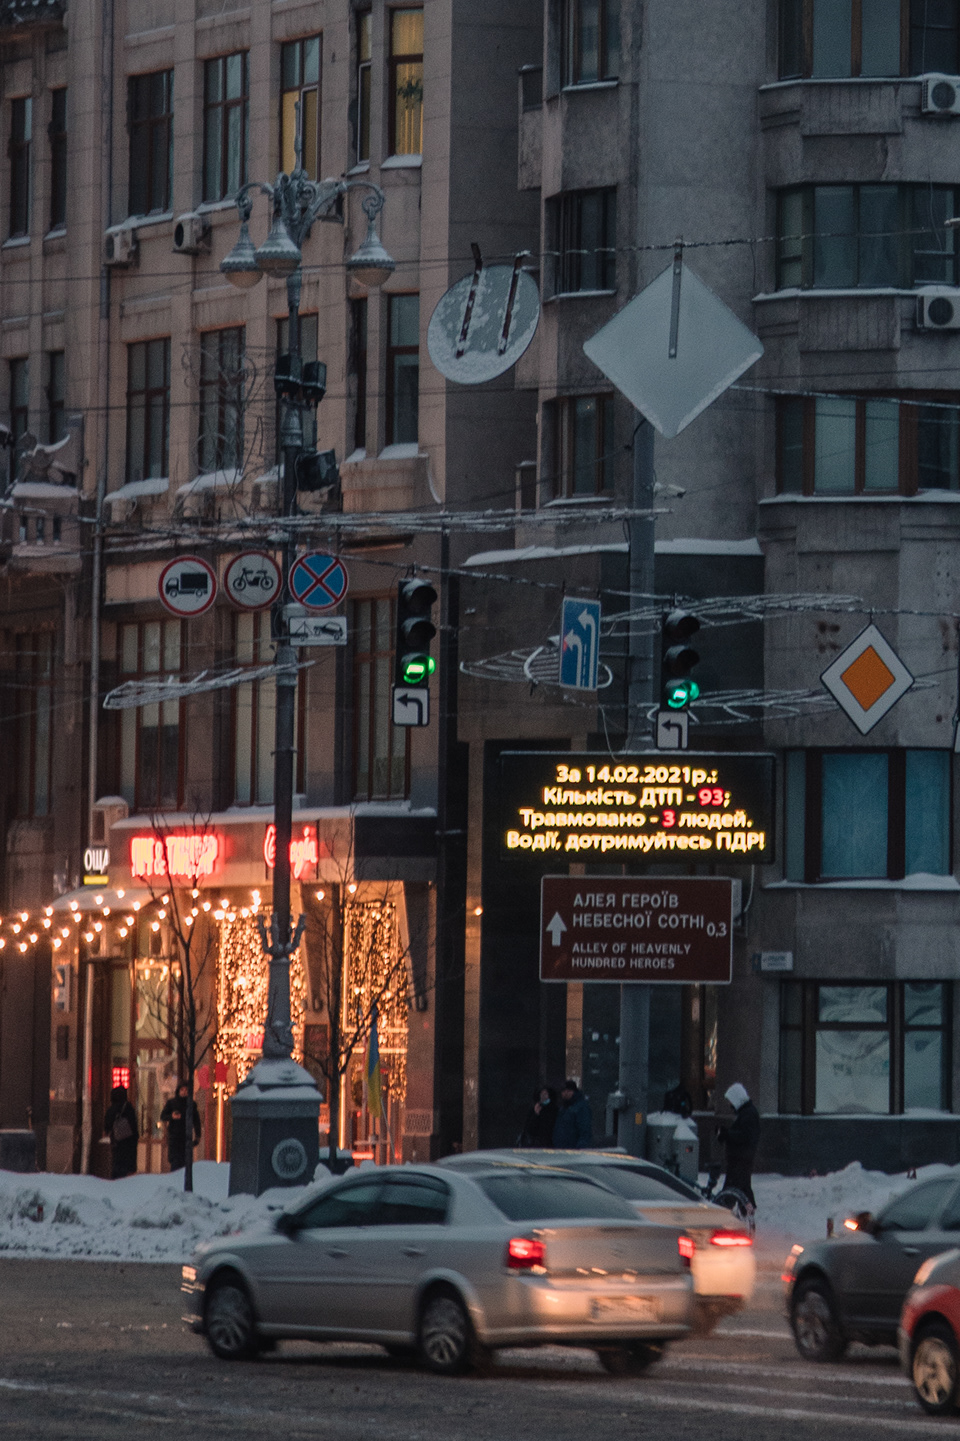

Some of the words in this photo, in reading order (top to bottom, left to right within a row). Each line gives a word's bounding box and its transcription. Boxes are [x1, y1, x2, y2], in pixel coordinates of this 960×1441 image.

[556, 765, 581, 783] За
[587, 765, 719, 787] 14.02.2021р.:
[543, 787, 637, 806] Кількість
[639, 787, 683, 808] ДТП
[518, 808, 646, 830] Травмовано
[662, 809, 676, 827] 3
[677, 810, 753, 830] людей.
[506, 831, 562, 852] Водії,
[565, 831, 713, 853] дотримуйтесь
[716, 831, 767, 853] ПДР!
[573, 893, 617, 908] АЛЕЯ
[621, 891, 679, 908] ГЕРОЇВ
[571, 911, 653, 929] НЕБЕСНОЇ
[657, 914, 705, 929] СОТНІ
[706, 922, 728, 938] 0,3
[571, 942, 608, 954] ALLEY
[612, 943, 627, 954] OF
[630, 943, 692, 955] HEAVENLY
[571, 957, 626, 969] HUNDRED
[629, 958, 676, 970] HEROES
